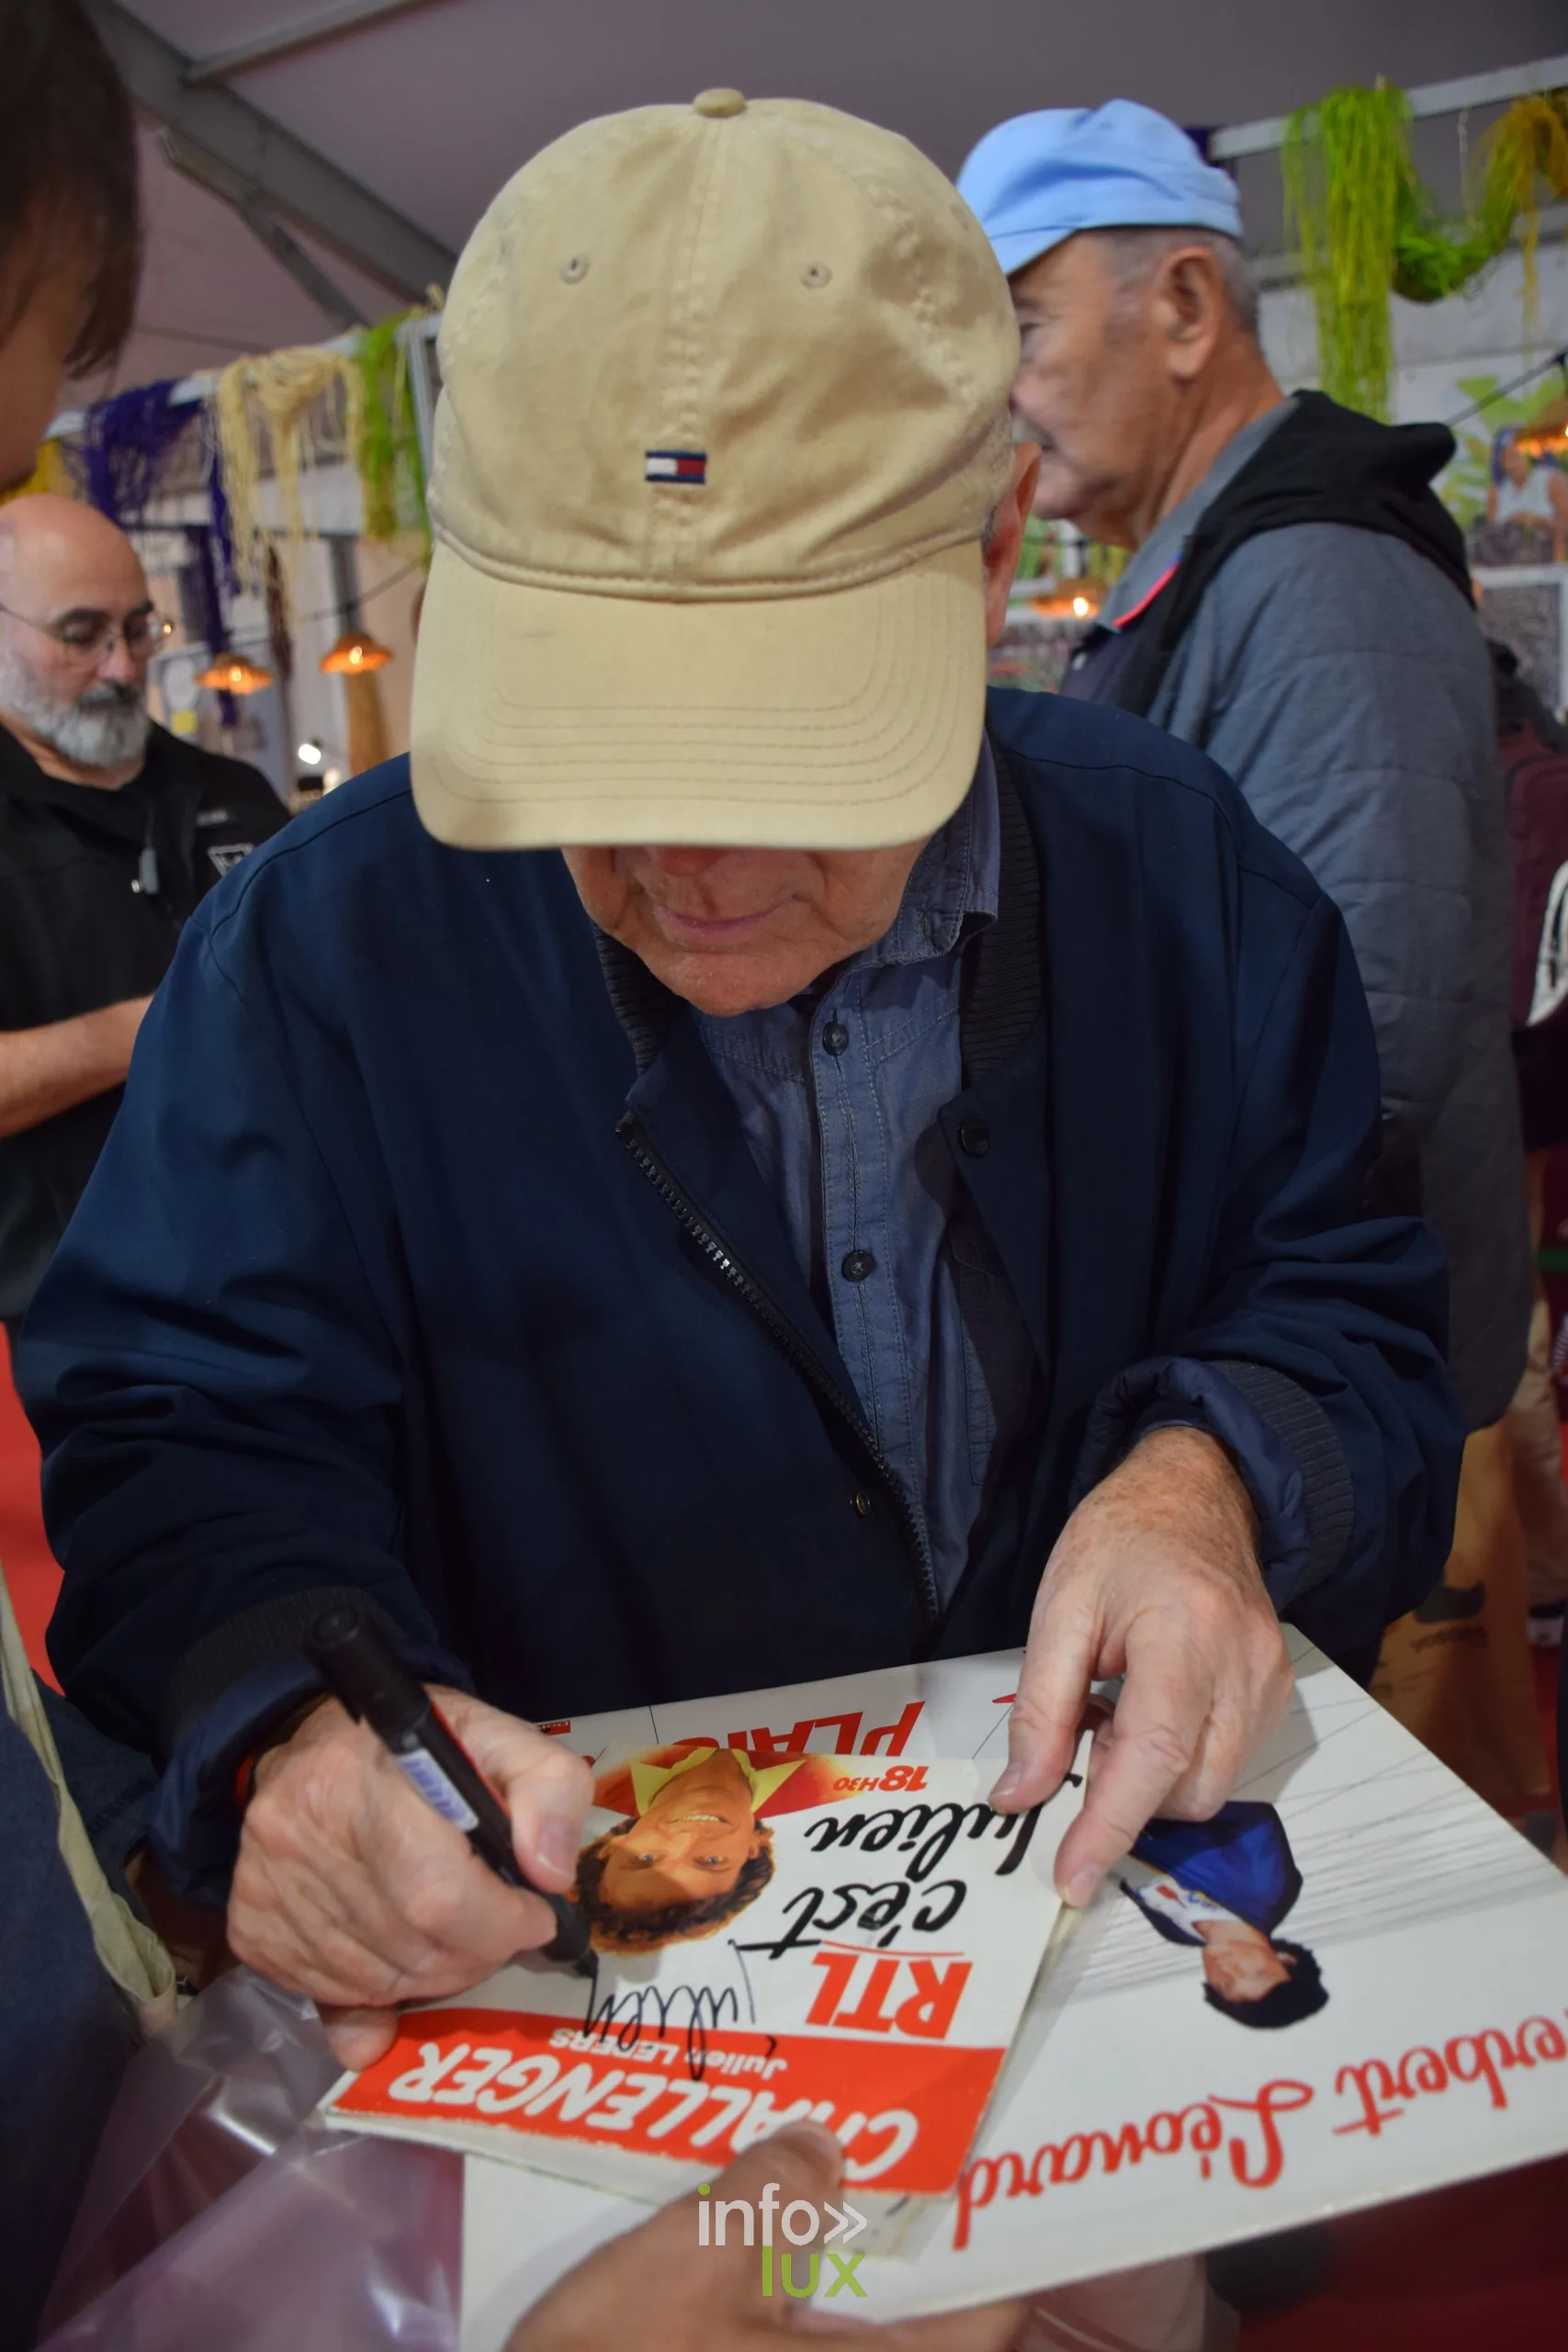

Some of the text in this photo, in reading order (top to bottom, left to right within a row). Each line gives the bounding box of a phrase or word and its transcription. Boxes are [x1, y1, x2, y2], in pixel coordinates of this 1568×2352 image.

[735, 1880, 967, 1959] c'est
[806, 1952, 974, 2040] RTL
[953, 2008, 1568, 2252] erbert Léonard
